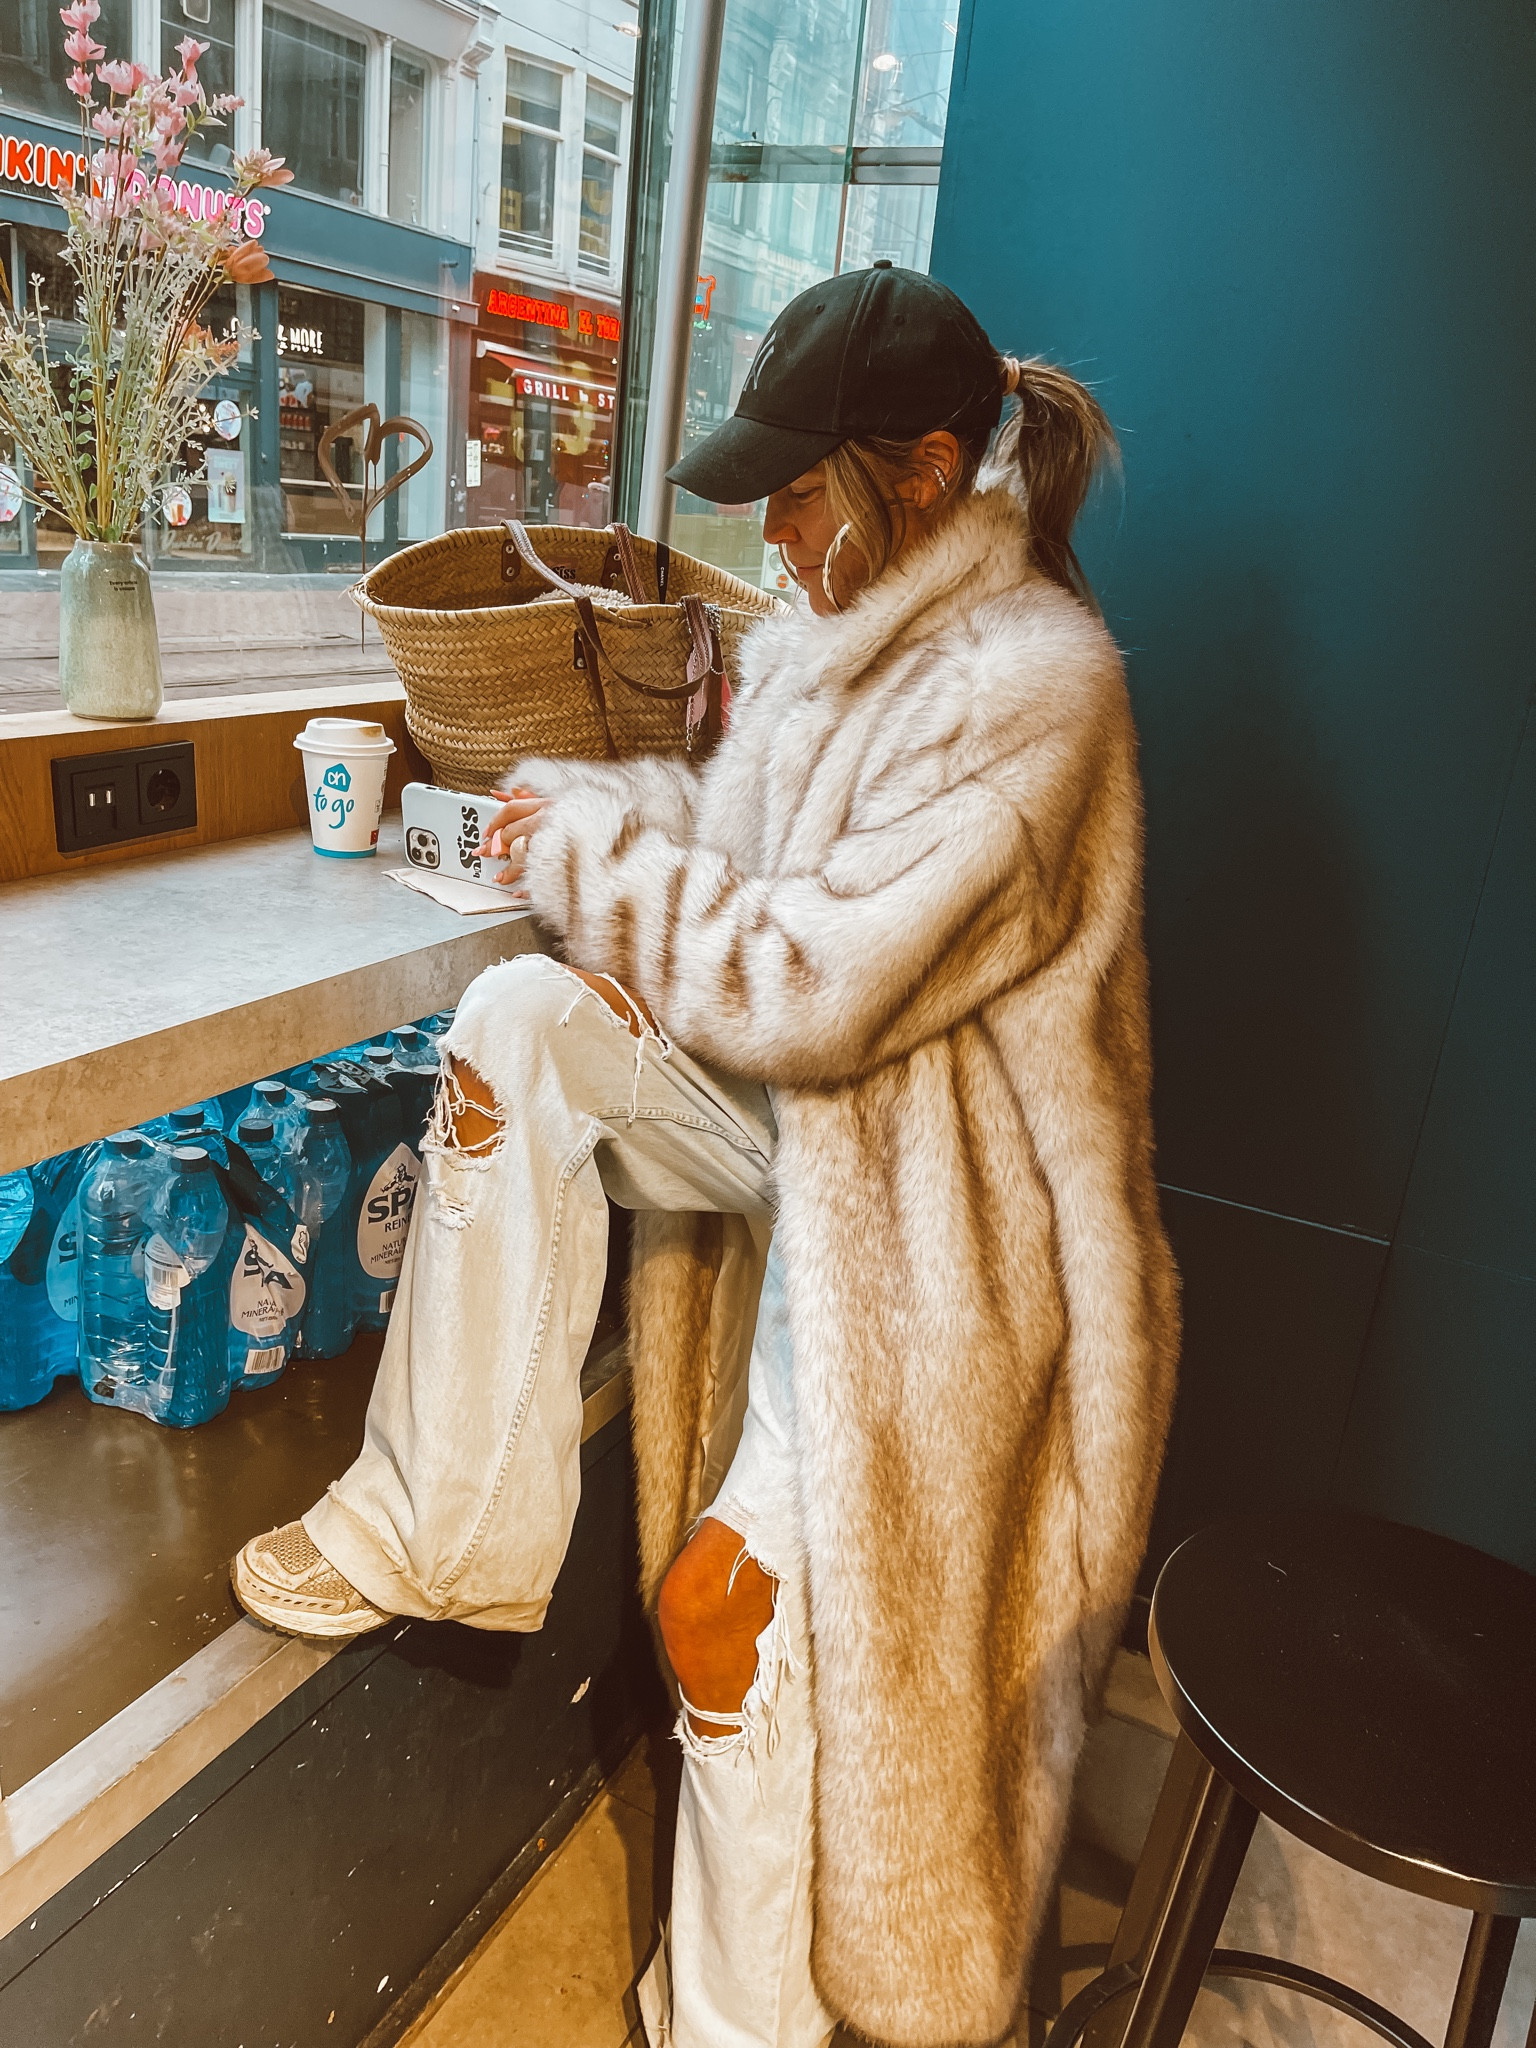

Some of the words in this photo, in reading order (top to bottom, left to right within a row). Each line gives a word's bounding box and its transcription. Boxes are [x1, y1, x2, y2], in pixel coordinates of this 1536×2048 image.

[487, 289, 569, 330] ARGENTINA
[578, 309, 594, 335] EL
[289, 327, 324, 355] MORE
[522, 378, 570, 401] GRILL
[313, 786, 327, 812] to
[328, 798, 354, 829] go
